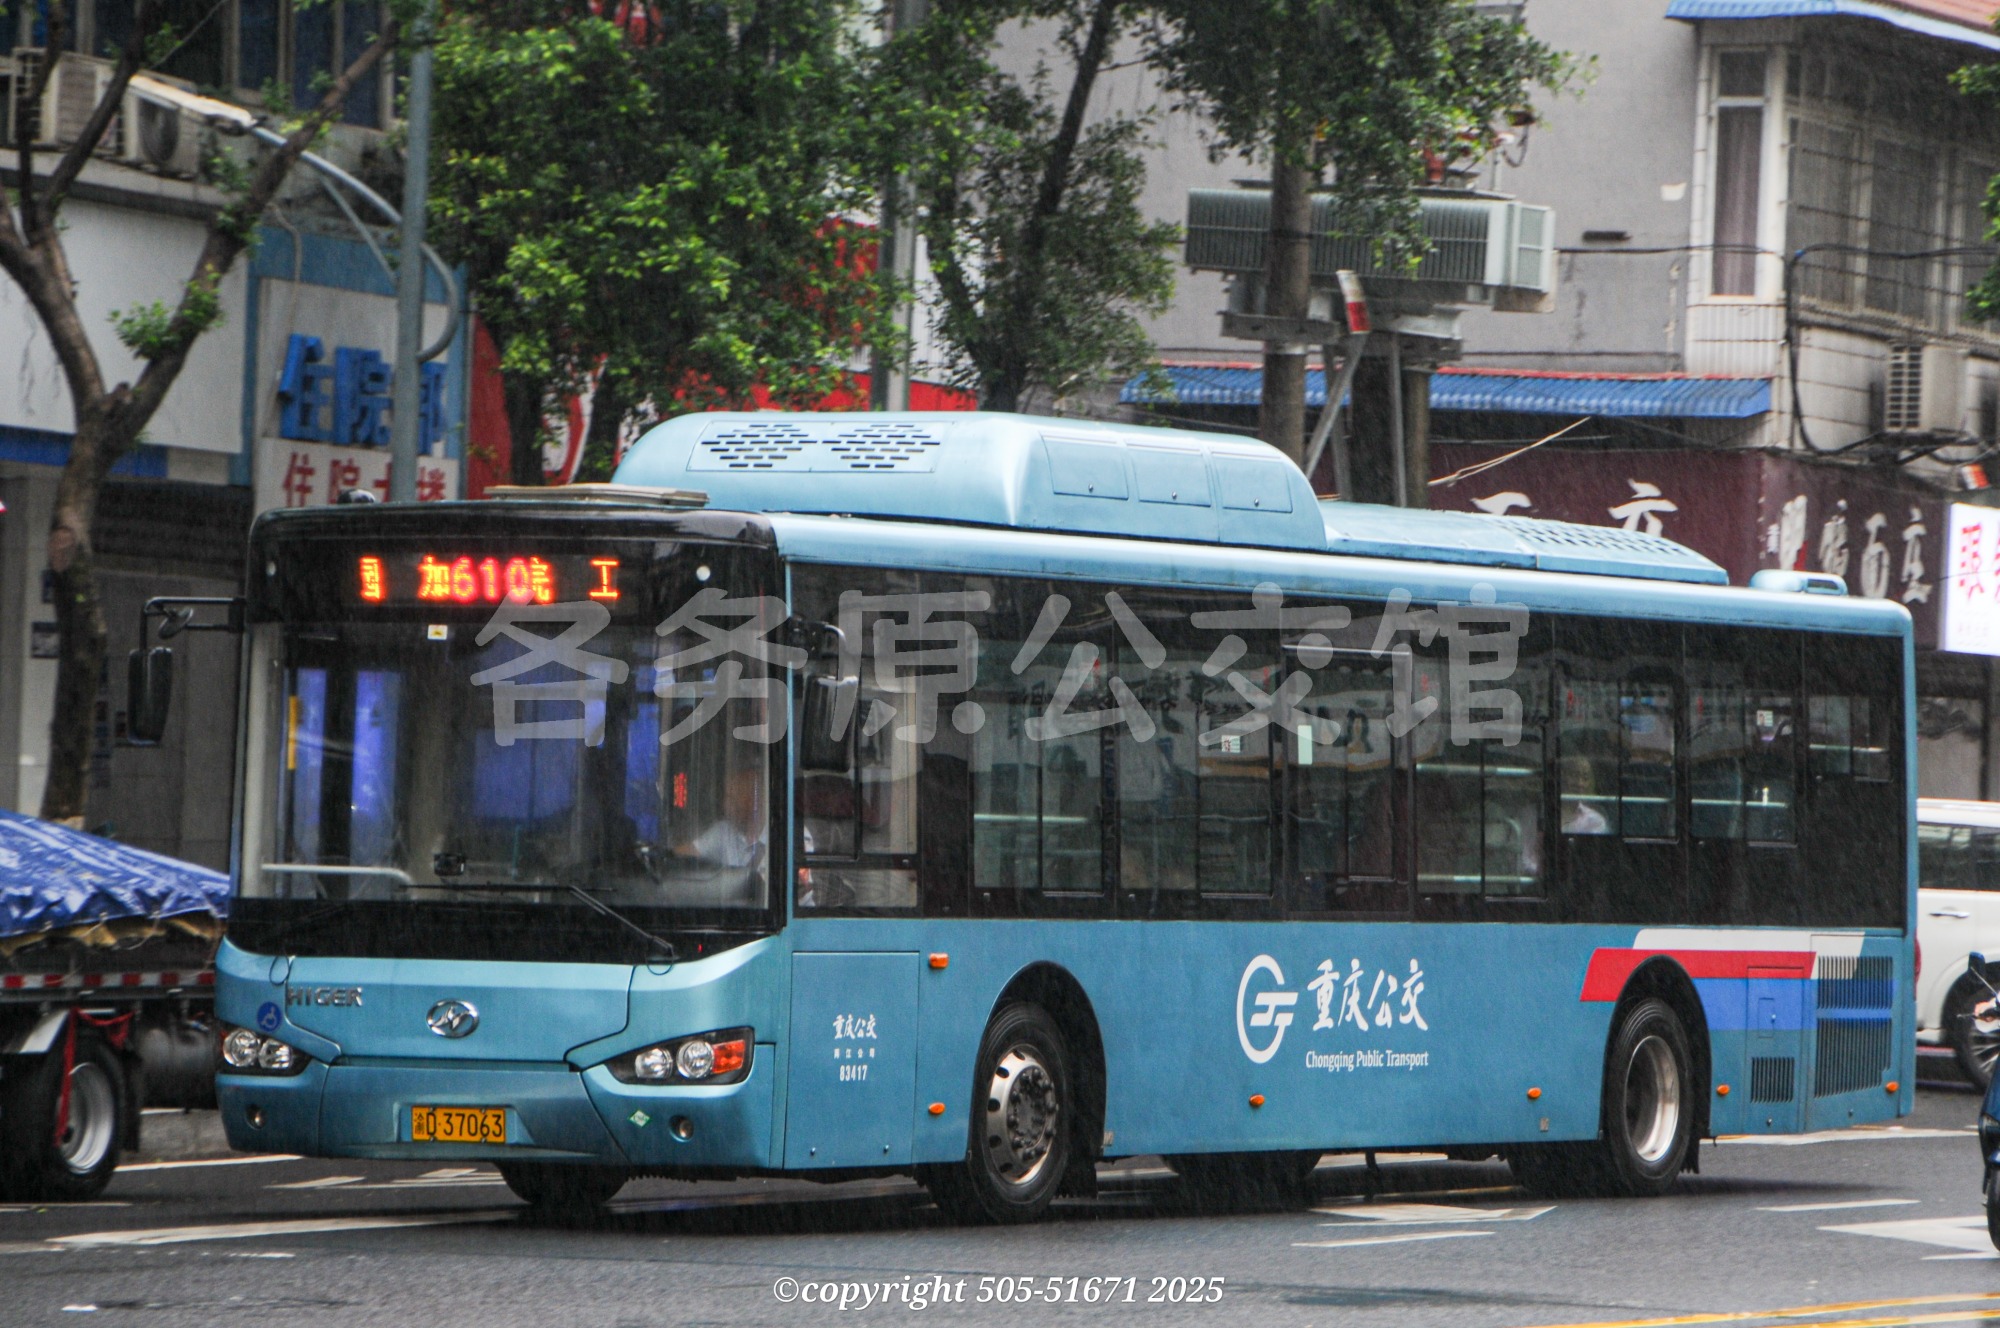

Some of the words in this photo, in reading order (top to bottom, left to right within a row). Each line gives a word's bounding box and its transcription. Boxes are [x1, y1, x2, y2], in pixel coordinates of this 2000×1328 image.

[287, 987, 363, 1007] HIGER
[1307, 958, 1429, 1032] 重庆公交
[832, 1013, 878, 1040] 重庆公交
[1305, 1050, 1354, 1072] Chongqing
[1355, 1049, 1384, 1069] Public
[1385, 1049, 1429, 1071] Transport
[839, 1064, 868, 1082] 83417
